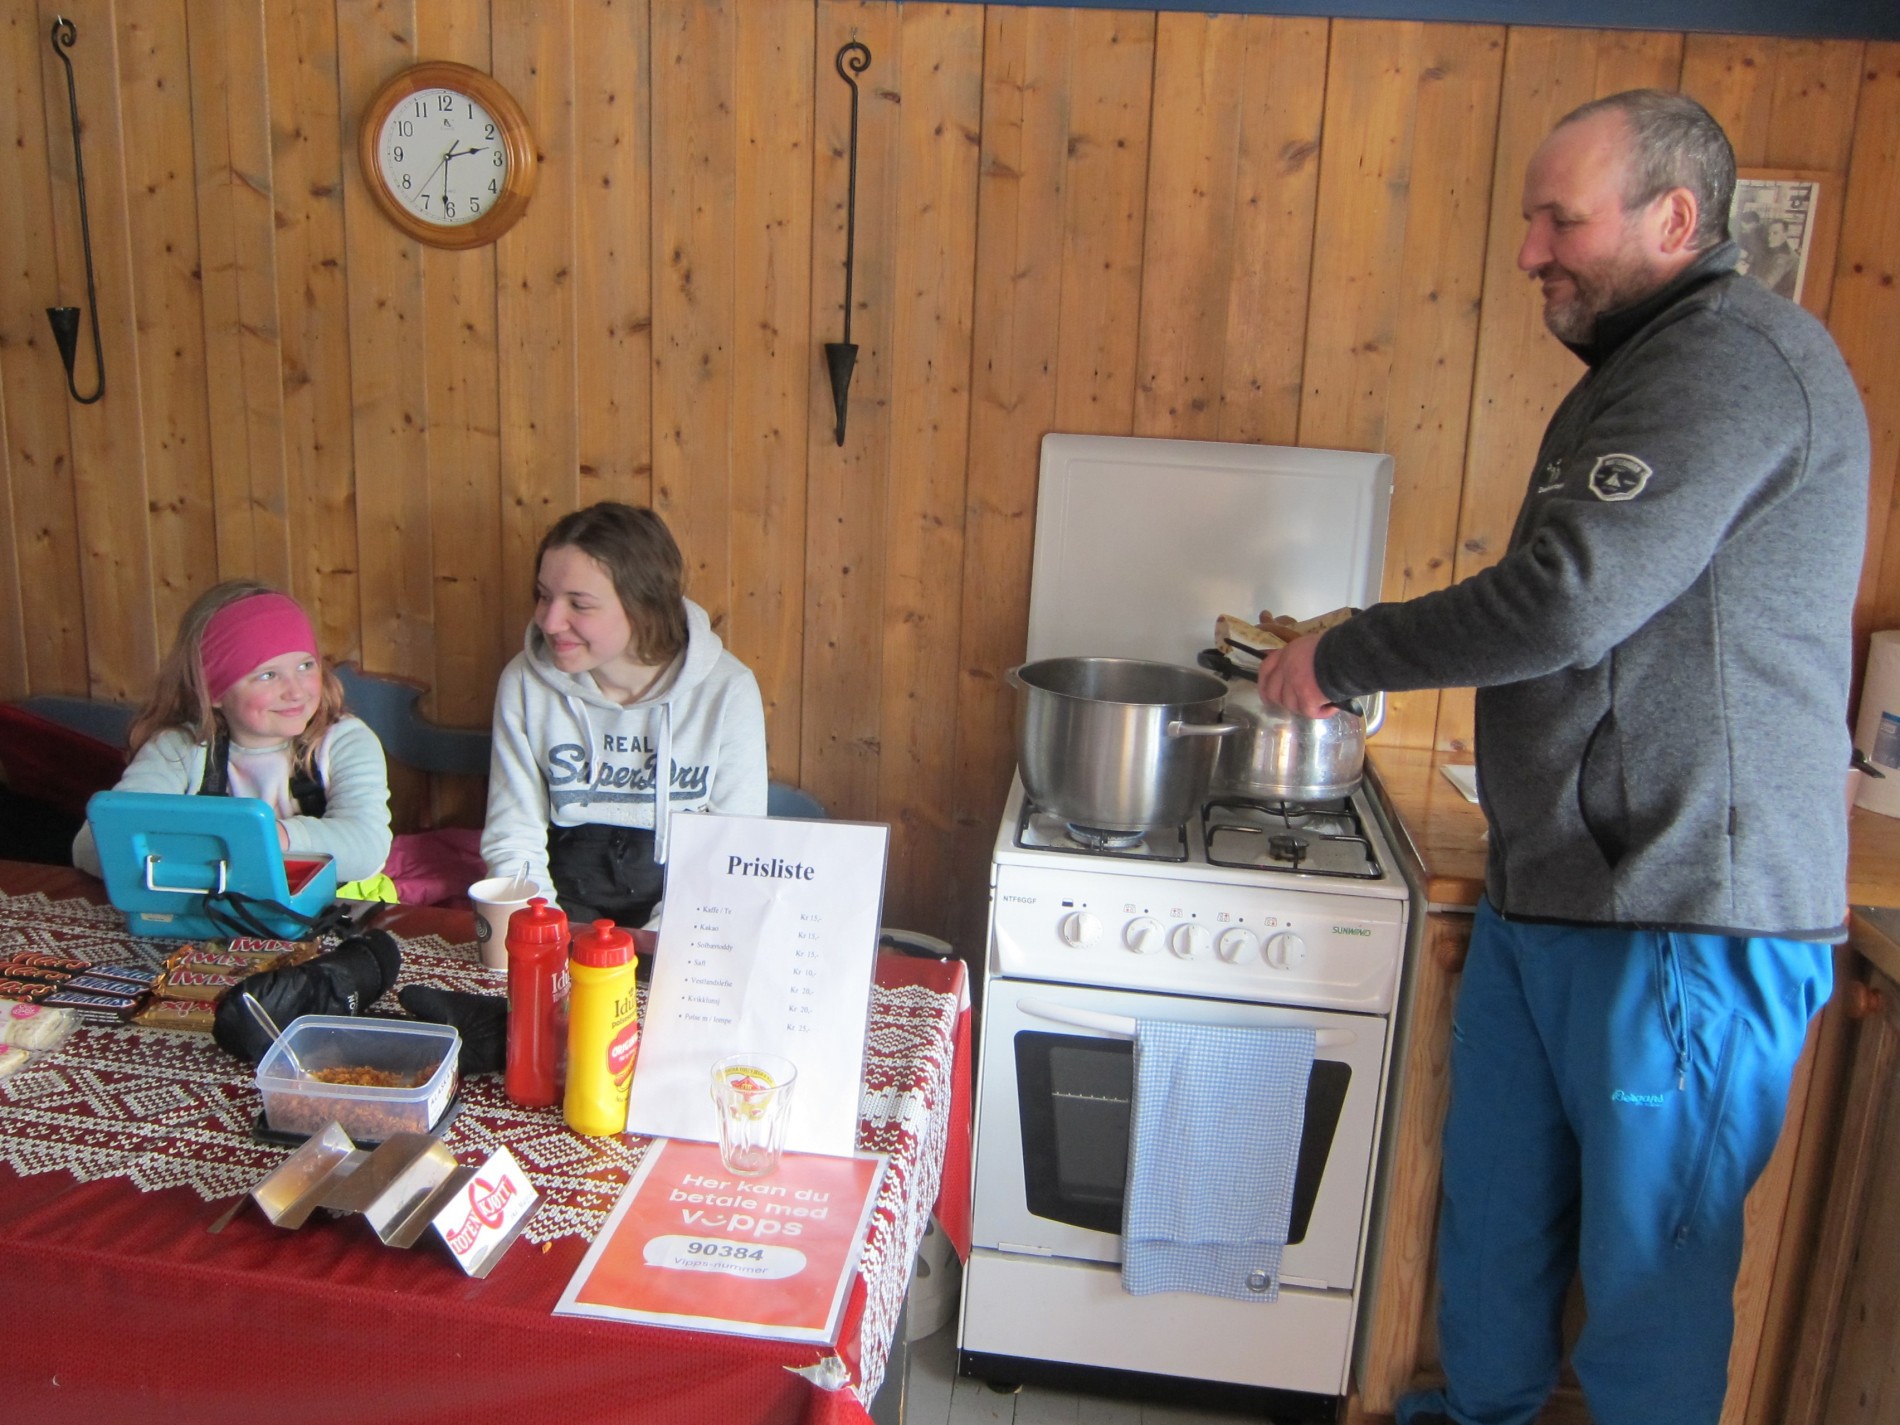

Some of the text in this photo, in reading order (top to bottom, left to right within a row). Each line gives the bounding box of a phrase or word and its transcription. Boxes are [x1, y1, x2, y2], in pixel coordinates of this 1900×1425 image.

[415, 102, 427, 118] 11
[438, 95, 453, 112] 12
[398, 120, 413, 137] 10
[485, 124, 494, 140] 2
[393, 146, 404, 162] 9
[493, 151, 503, 167] 3
[402, 173, 412, 189] 8
[488, 178, 497, 194] 4
[421, 194, 430, 210] 7
[446, 202, 455, 218] 6
[470, 197, 480, 212] 5
[604, 734, 654, 753] REAL
[727, 855, 815, 881] Prisliste
[703, 906, 719, 914] Kaffe
[800, 913, 808, 921] Kr
[798, 931, 806, 939] Kr
[795, 949, 804, 958] Kr
[793, 967, 801, 975] Kr
[790, 986, 799, 994] Kr
[787, 1023, 795, 1031] Kr
[682, 1174, 830, 1203] Her kan du
[669, 1188, 828, 1219] betale med
[687, 1242, 764, 1261] 90384
[674, 1257, 769, 1274] Vipps-nummer
